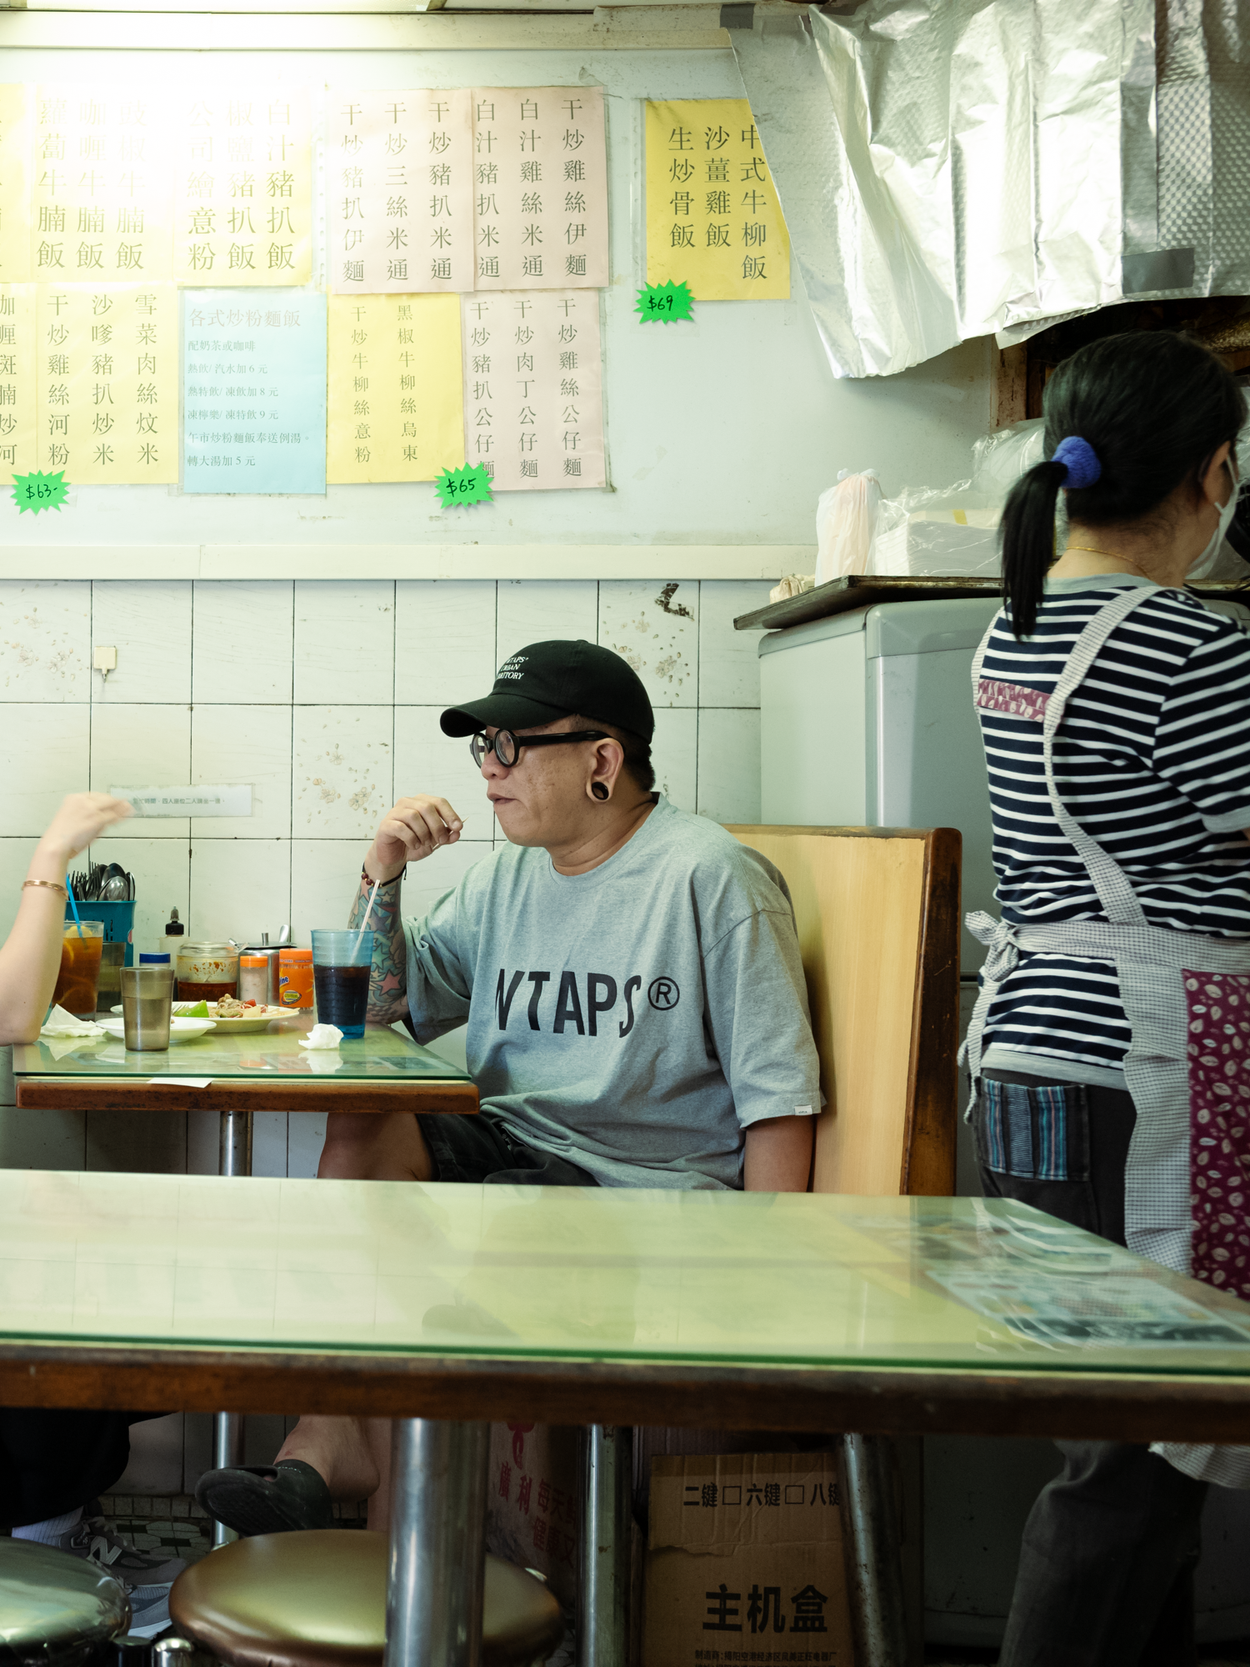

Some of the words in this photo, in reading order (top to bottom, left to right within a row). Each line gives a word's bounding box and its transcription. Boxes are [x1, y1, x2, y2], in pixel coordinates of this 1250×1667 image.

[37, 98, 67, 269] 蘿蔔牛腩飯
[76, 98, 106, 269] 咖喱牛腩飯
[115, 98, 146, 269] 豉椒牛腩飯
[225, 99, 257, 270] 椒鹽豬扒飯
[266, 99, 296, 270] 白汁豬扒飯
[340, 102, 365, 283] 干炒豬扒伊麵
[384, 102, 409, 282] 干炒三絲米通
[427, 100, 453, 281] 干炒豬扒米通
[475, 98, 501, 280] 白汁豬扒米通
[518, 97, 544, 278] 白汁雞絲米通
[560, 97, 587, 277] 干炒雞絲伊麵
[668, 126, 696, 248] 生炒骨飯
[704, 125, 731, 247] 沙薑雞飯
[739, 124, 767, 280] 中式牛柳飯
[47, 294, 70, 466] 干炒雞絲河粉
[91, 294, 114, 466] 沙嗲豬扒炒米
[135, 294, 159, 466] 雪菜肉絲炆米
[188, 340, 256, 352] 配奶茶或咖啡
[189, 308, 301, 328] 各式炒粉麵飯
[350, 305, 372, 464] 干炒牛柳絲意粉
[397, 304, 418, 462] 黑椒牛柳絲烏東
[513, 299, 539, 479] 干炒肉丁公仔麵
[557, 297, 582, 477] 干炒雞絲公仔麵
[647, 295, 673, 312] $69
[447, 477, 476, 496] $65
[702, 1583, 829, 1634] 主机盒
